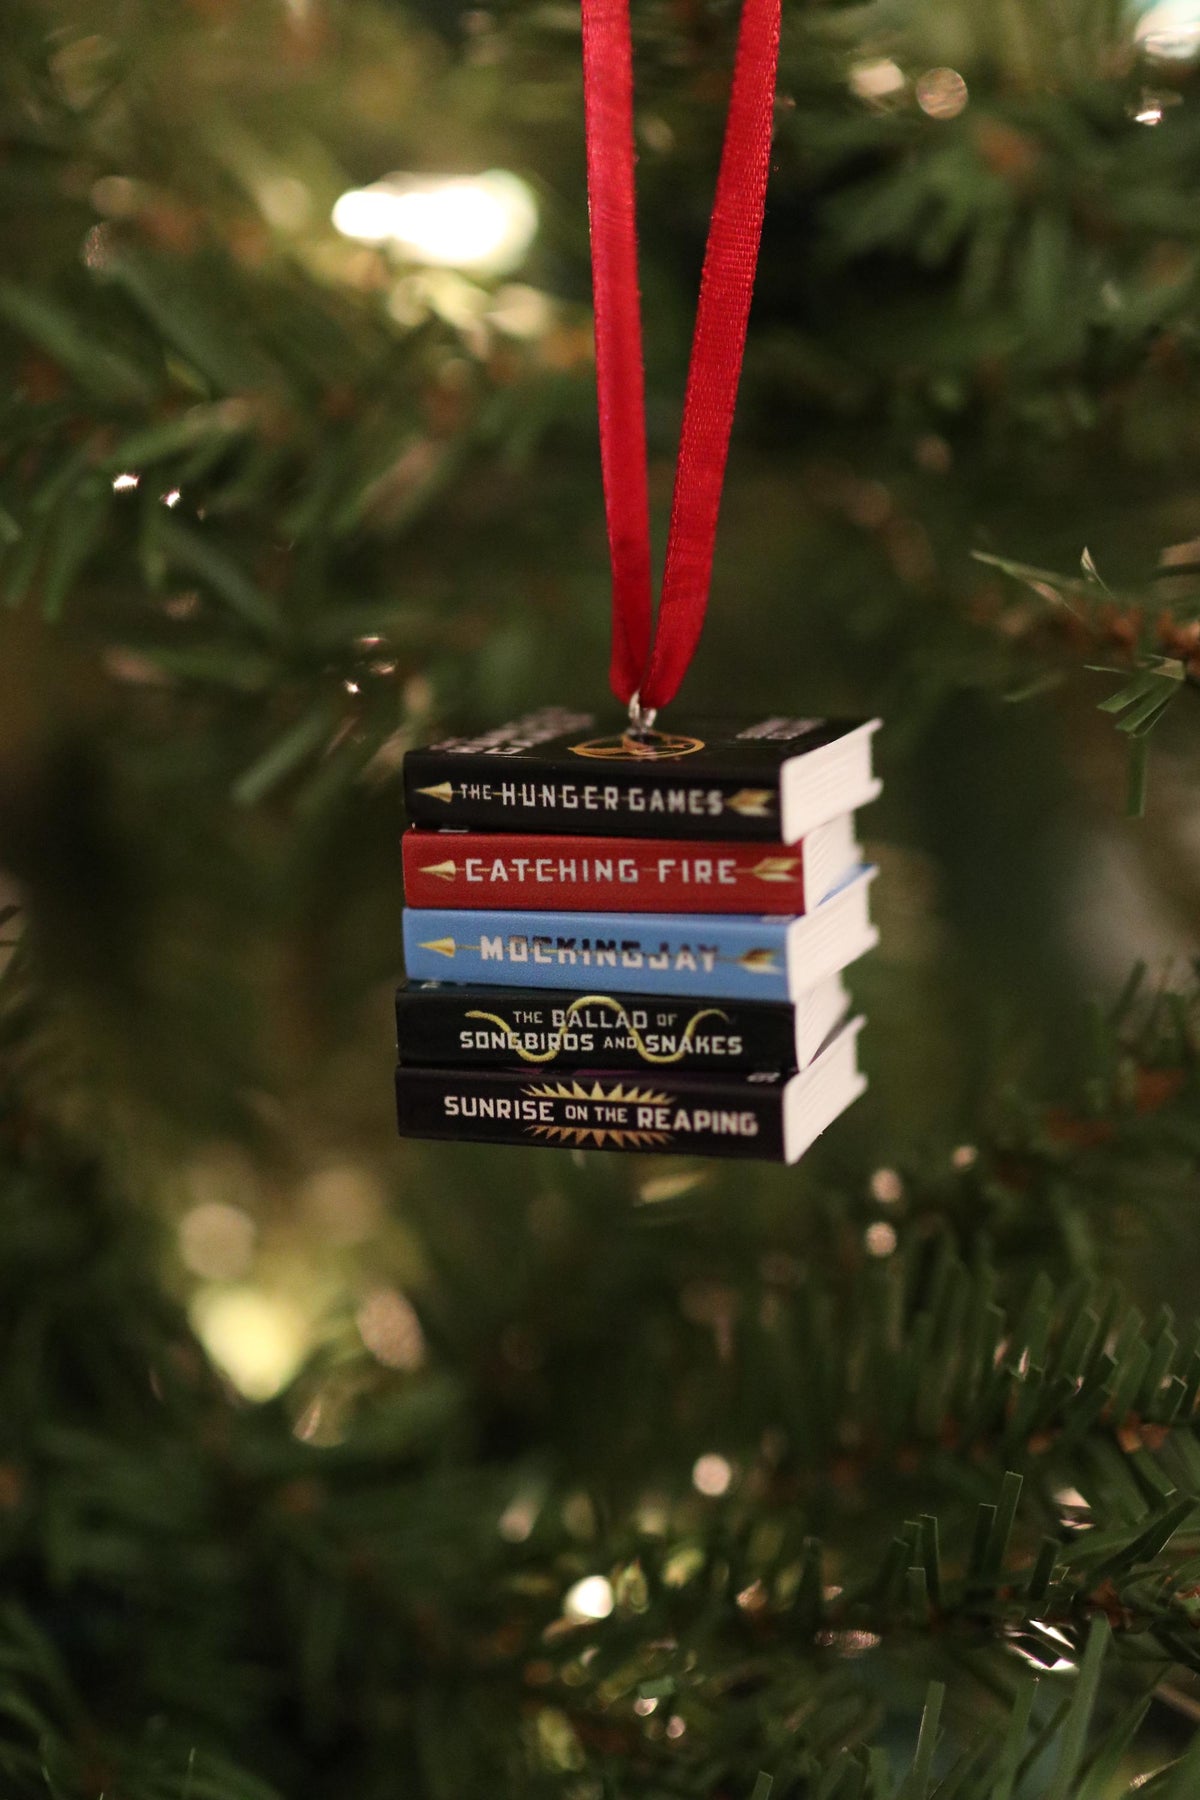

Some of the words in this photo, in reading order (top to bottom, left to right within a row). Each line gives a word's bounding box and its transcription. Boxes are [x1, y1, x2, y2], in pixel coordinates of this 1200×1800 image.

[460, 782, 492, 801] THE
[502, 782, 618, 809] HUNGER
[629, 788, 723, 816] GAMES
[466, 859, 639, 883] CATCHING
[659, 860, 737, 884] FIRE
[480, 935, 719, 973] MOCKINGJAY
[513, 1011, 543, 1025] THE
[552, 1010, 648, 1029] BALLAD
[657, 1015, 678, 1027] OF
[460, 1031, 594, 1051] SONGBIRDS
[604, 1037, 638, 1050] AND
[646, 1036, 743, 1056] SNAKES
[444, 1096, 554, 1122] SUNRISE
[565, 1105, 589, 1121] ON
[594, 1106, 628, 1124] THE
[637, 1106, 759, 1137] REAPING
